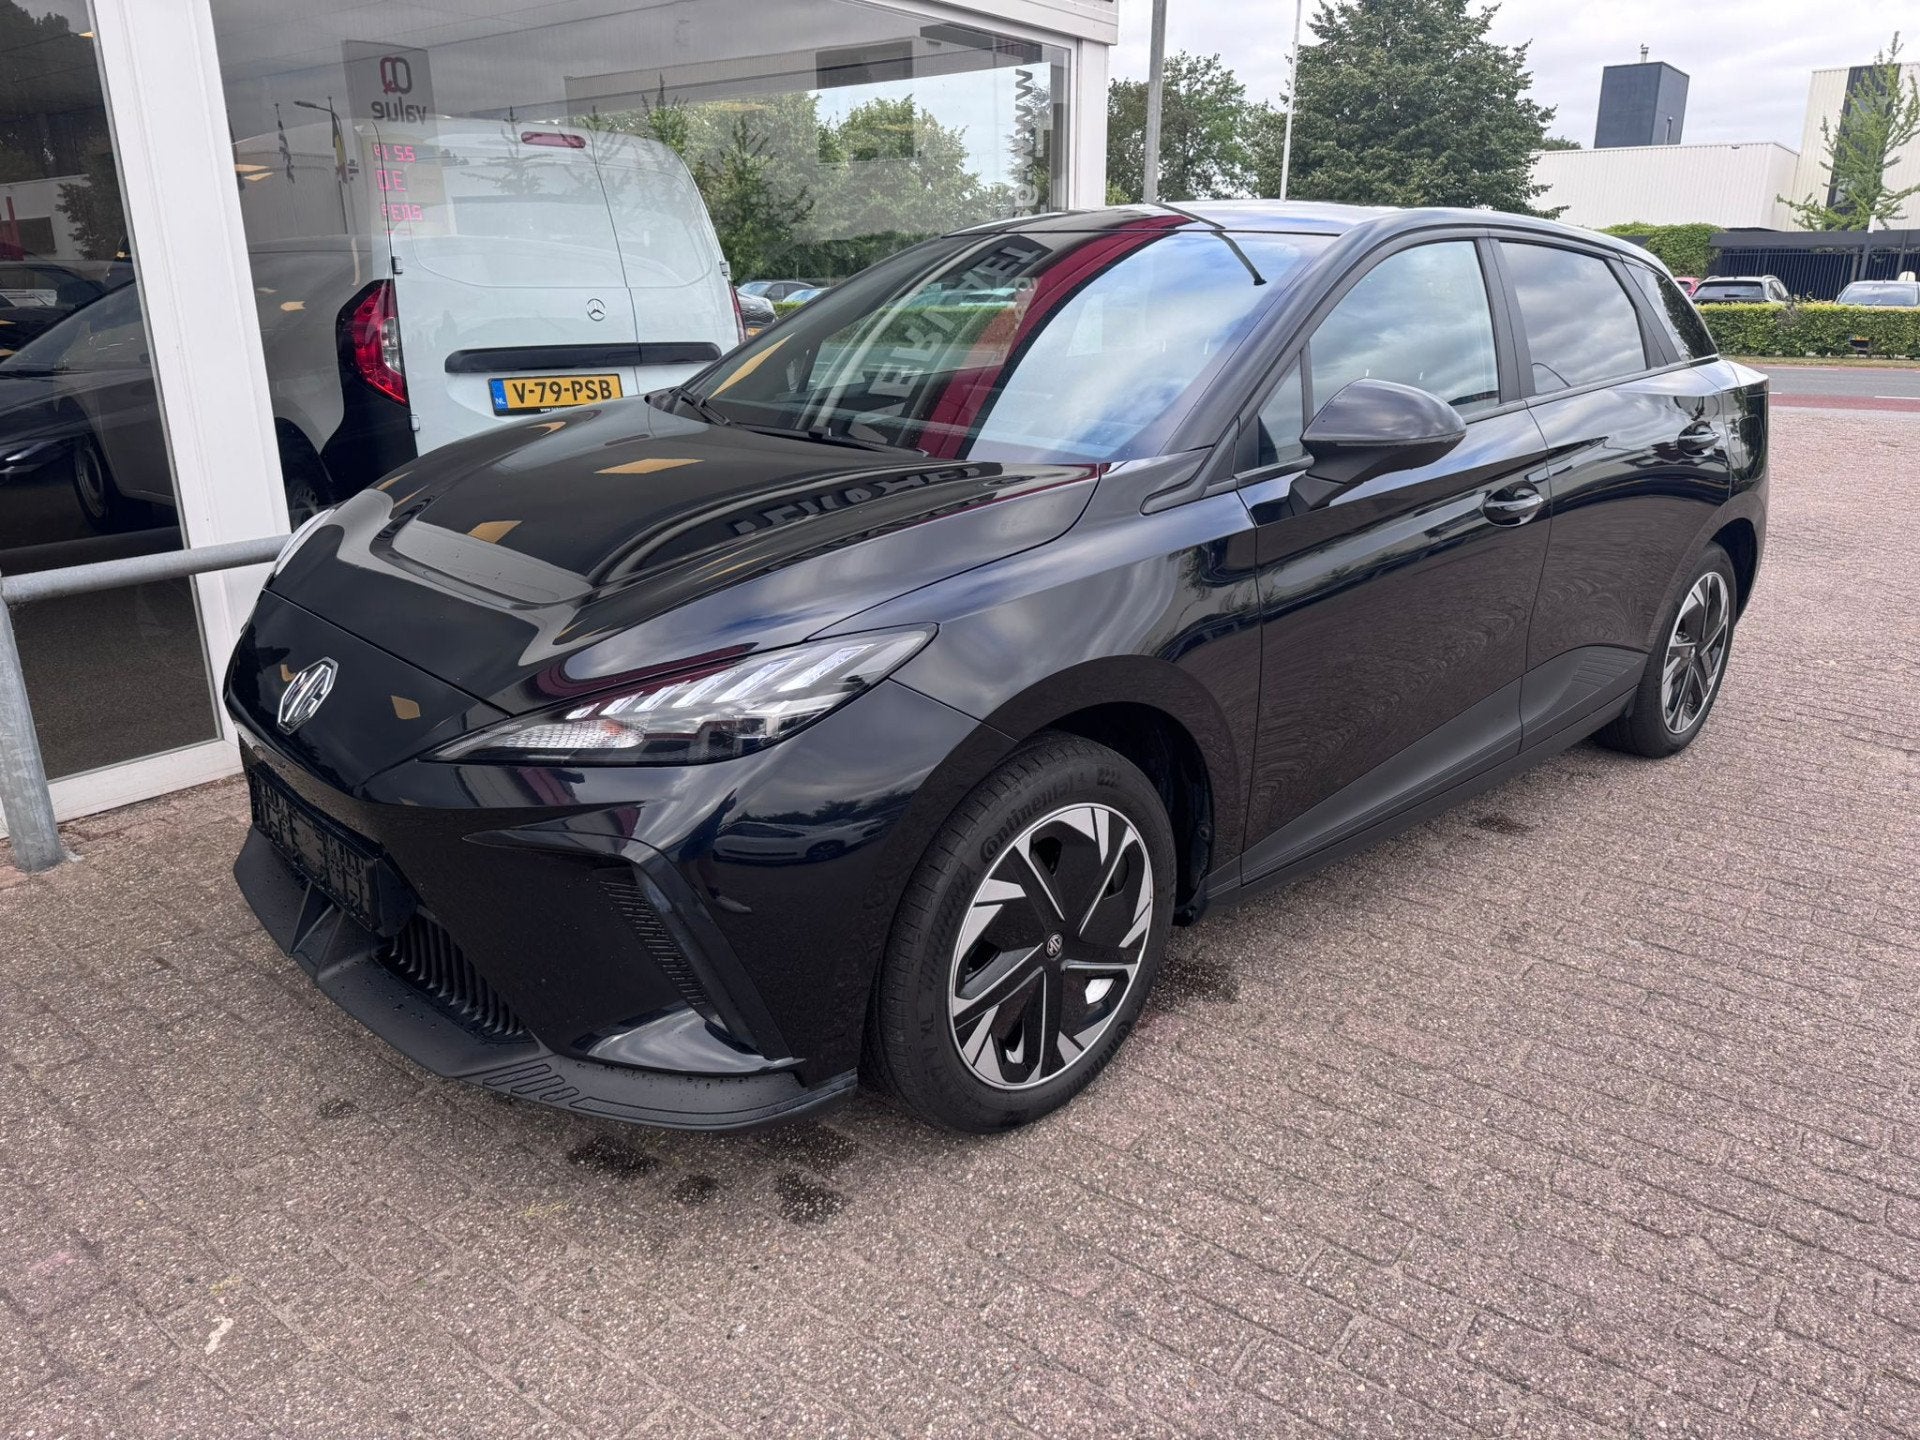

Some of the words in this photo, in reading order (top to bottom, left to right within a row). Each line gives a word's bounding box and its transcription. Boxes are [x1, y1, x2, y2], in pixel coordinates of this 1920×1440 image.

[495, 397, 506, 405] NL
[512, 379, 612, 404] V-79-PSB
[280, 660, 336, 730] MG
